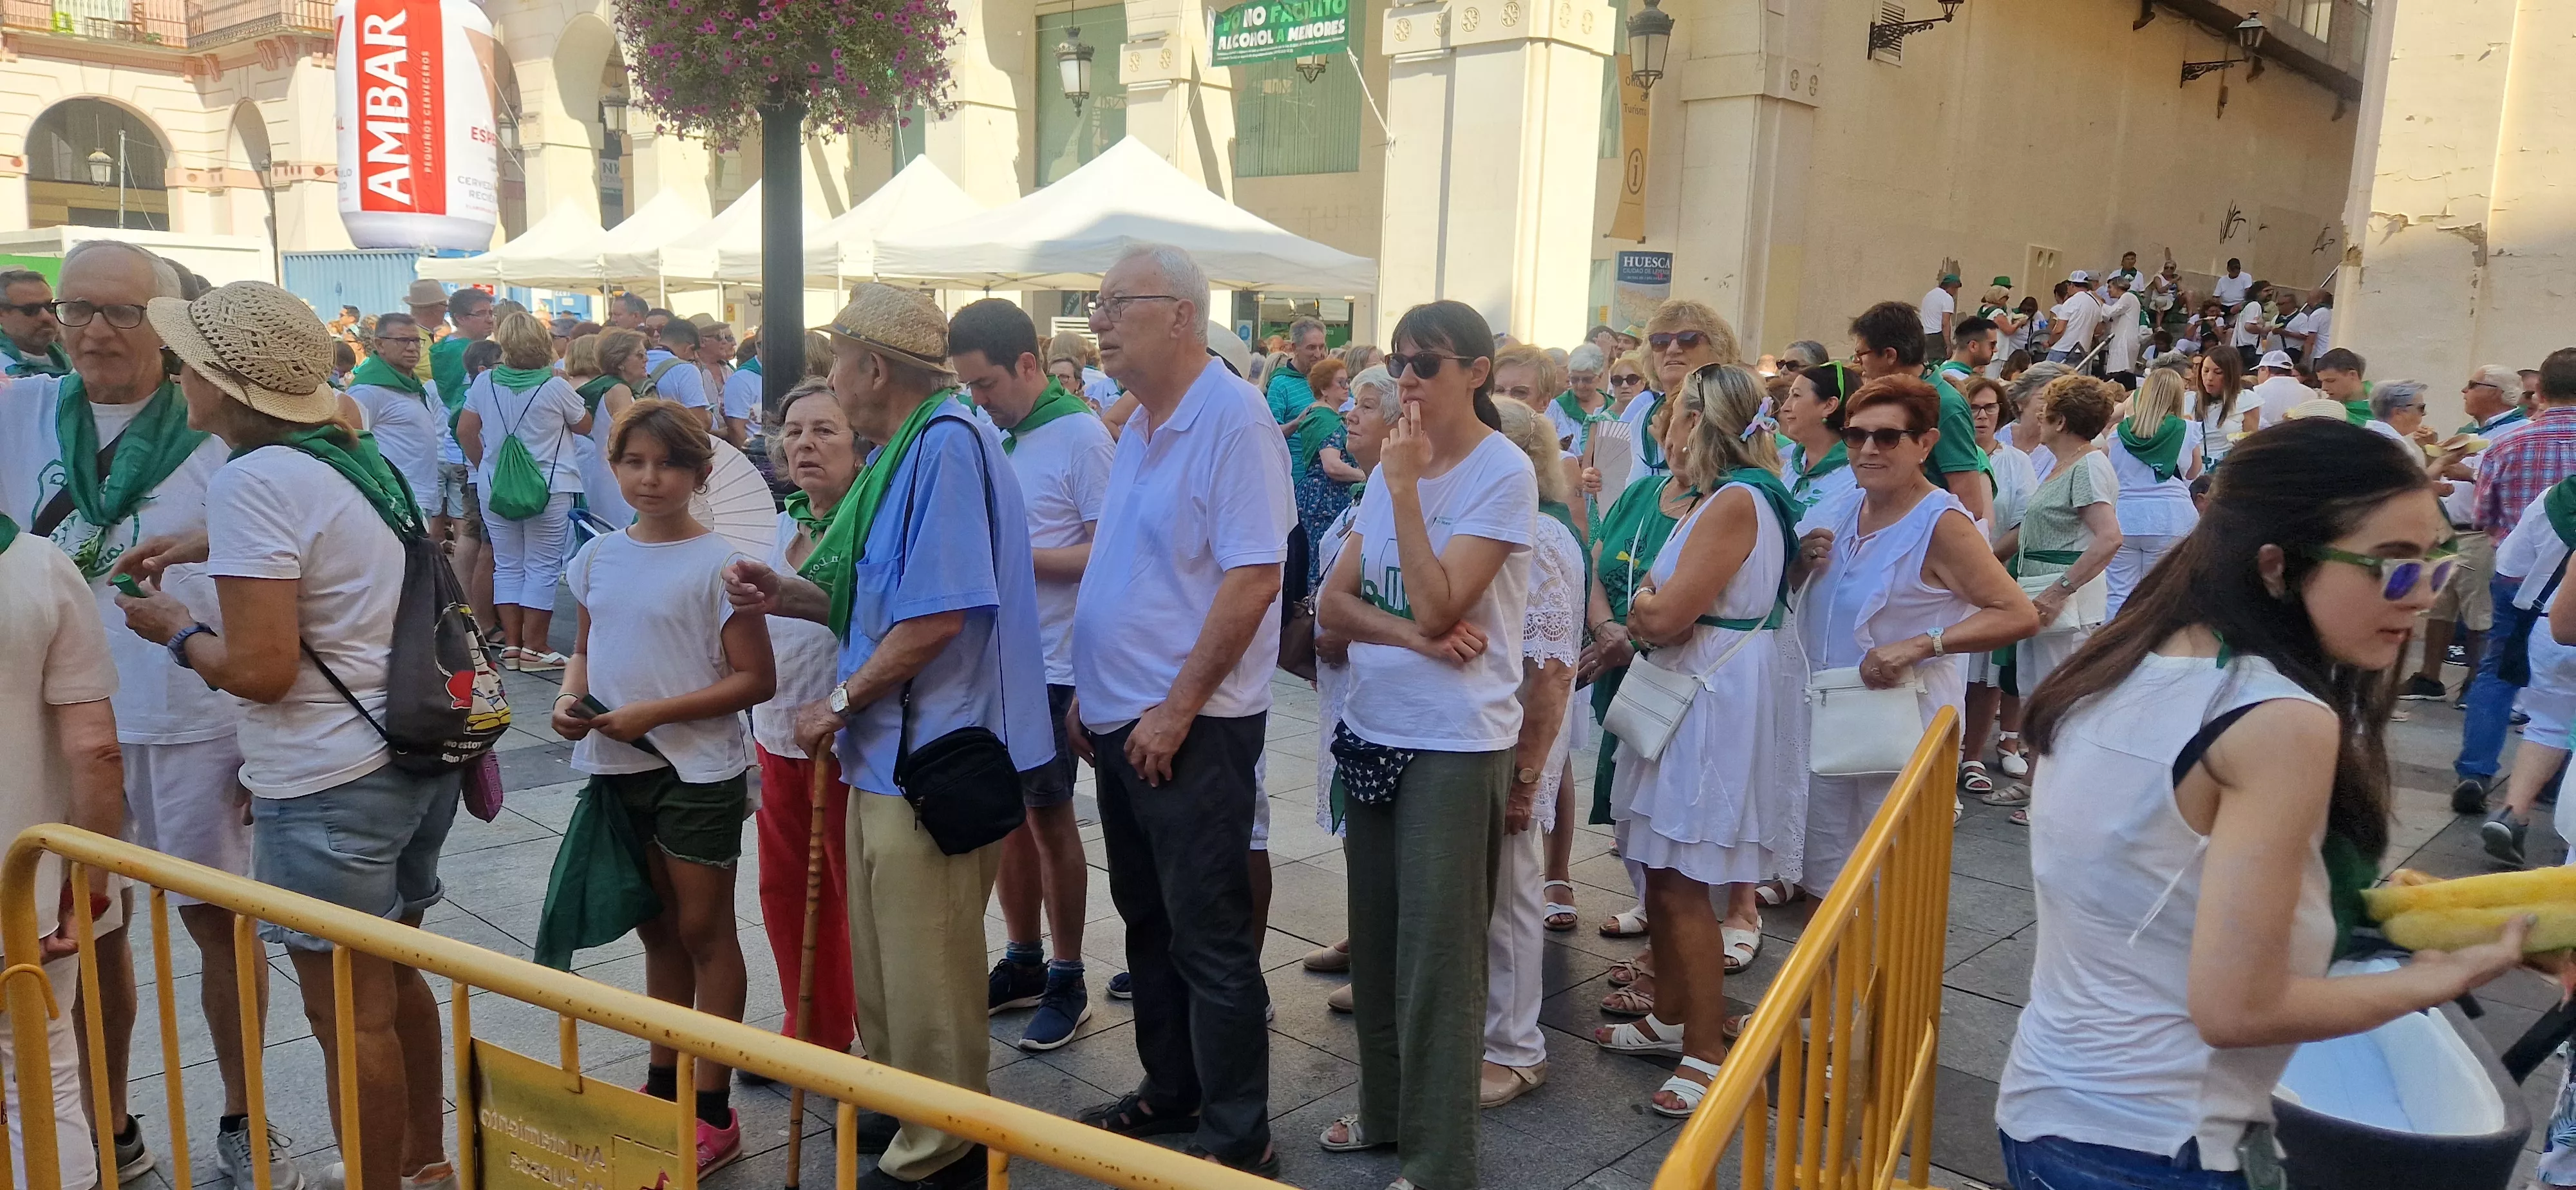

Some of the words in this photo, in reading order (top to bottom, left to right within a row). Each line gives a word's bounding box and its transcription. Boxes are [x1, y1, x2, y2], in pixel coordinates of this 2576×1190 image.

[1224, 12, 1240, 31] YO
[1243, 6, 1266, 27] NO
[1270, 0, 1346, 23] FACILITO
[1218, 29, 1273, 50] ALCOHOL
[1276, 28, 1285, 42] A
[1287, 19, 1345, 41] MENORES
[421, 51, 432, 116] CERVECEROS
[363, 8, 411, 205] AMBAR
[422, 120, 433, 173] PEQUEÑOS
[1624, 256, 1670, 269] HUESCA
[442, 752, 459, 763] sino
[458, 741, 483, 750] estoy
